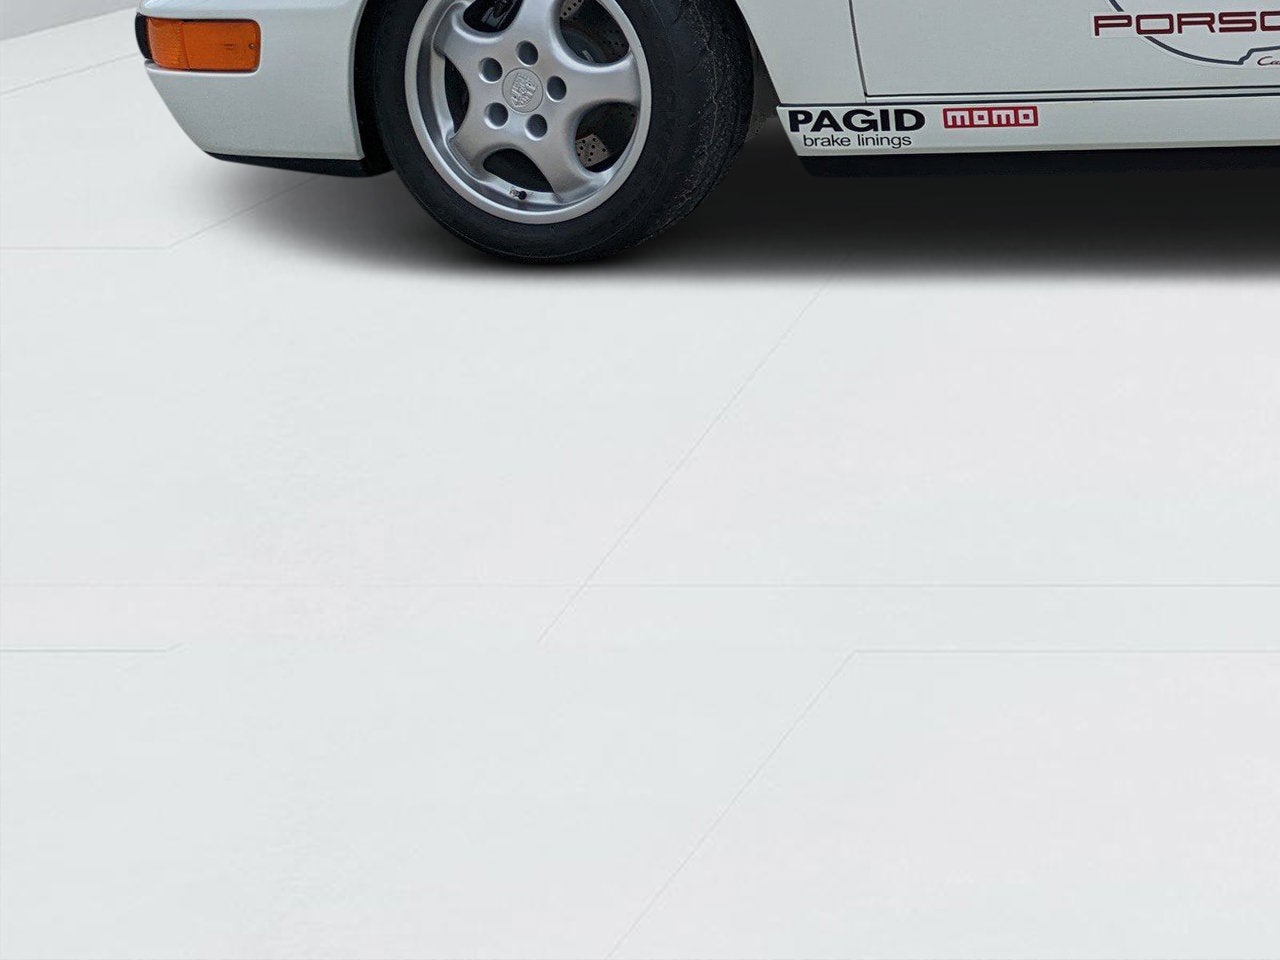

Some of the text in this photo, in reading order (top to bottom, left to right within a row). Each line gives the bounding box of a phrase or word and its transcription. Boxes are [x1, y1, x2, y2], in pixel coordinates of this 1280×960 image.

[788, 108, 926, 133] PAGID
[803, 133, 912, 149] brake linings
